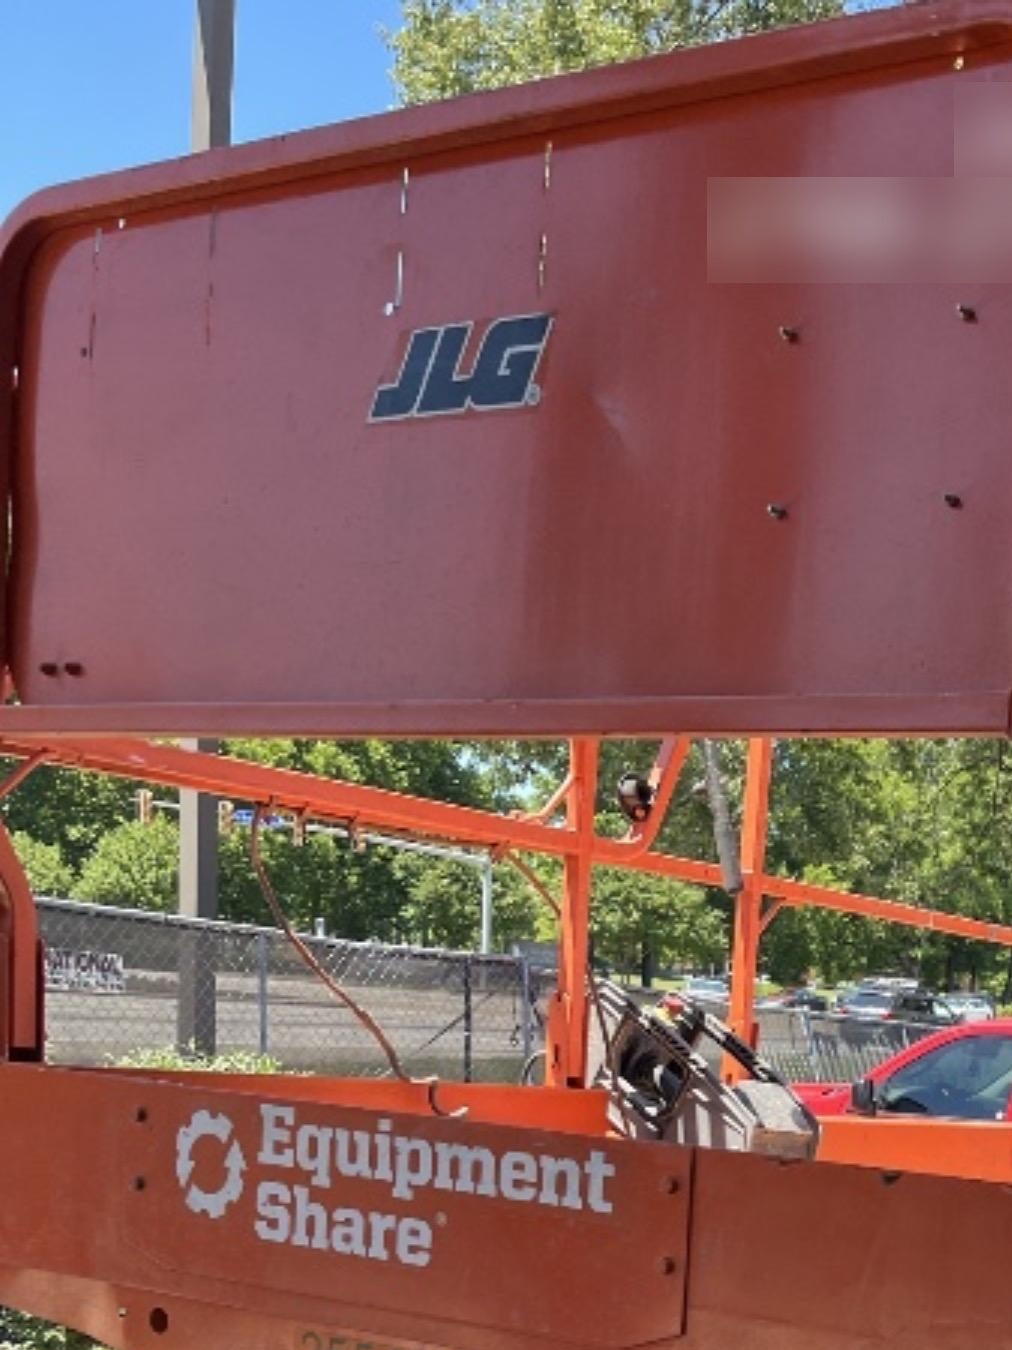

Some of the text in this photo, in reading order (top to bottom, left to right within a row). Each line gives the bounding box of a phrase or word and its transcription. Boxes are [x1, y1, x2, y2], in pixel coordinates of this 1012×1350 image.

[366, 312, 554, 424] JLG
[257, 1104, 616, 1213] Equipment
[255, 1182, 433, 1267] Share
